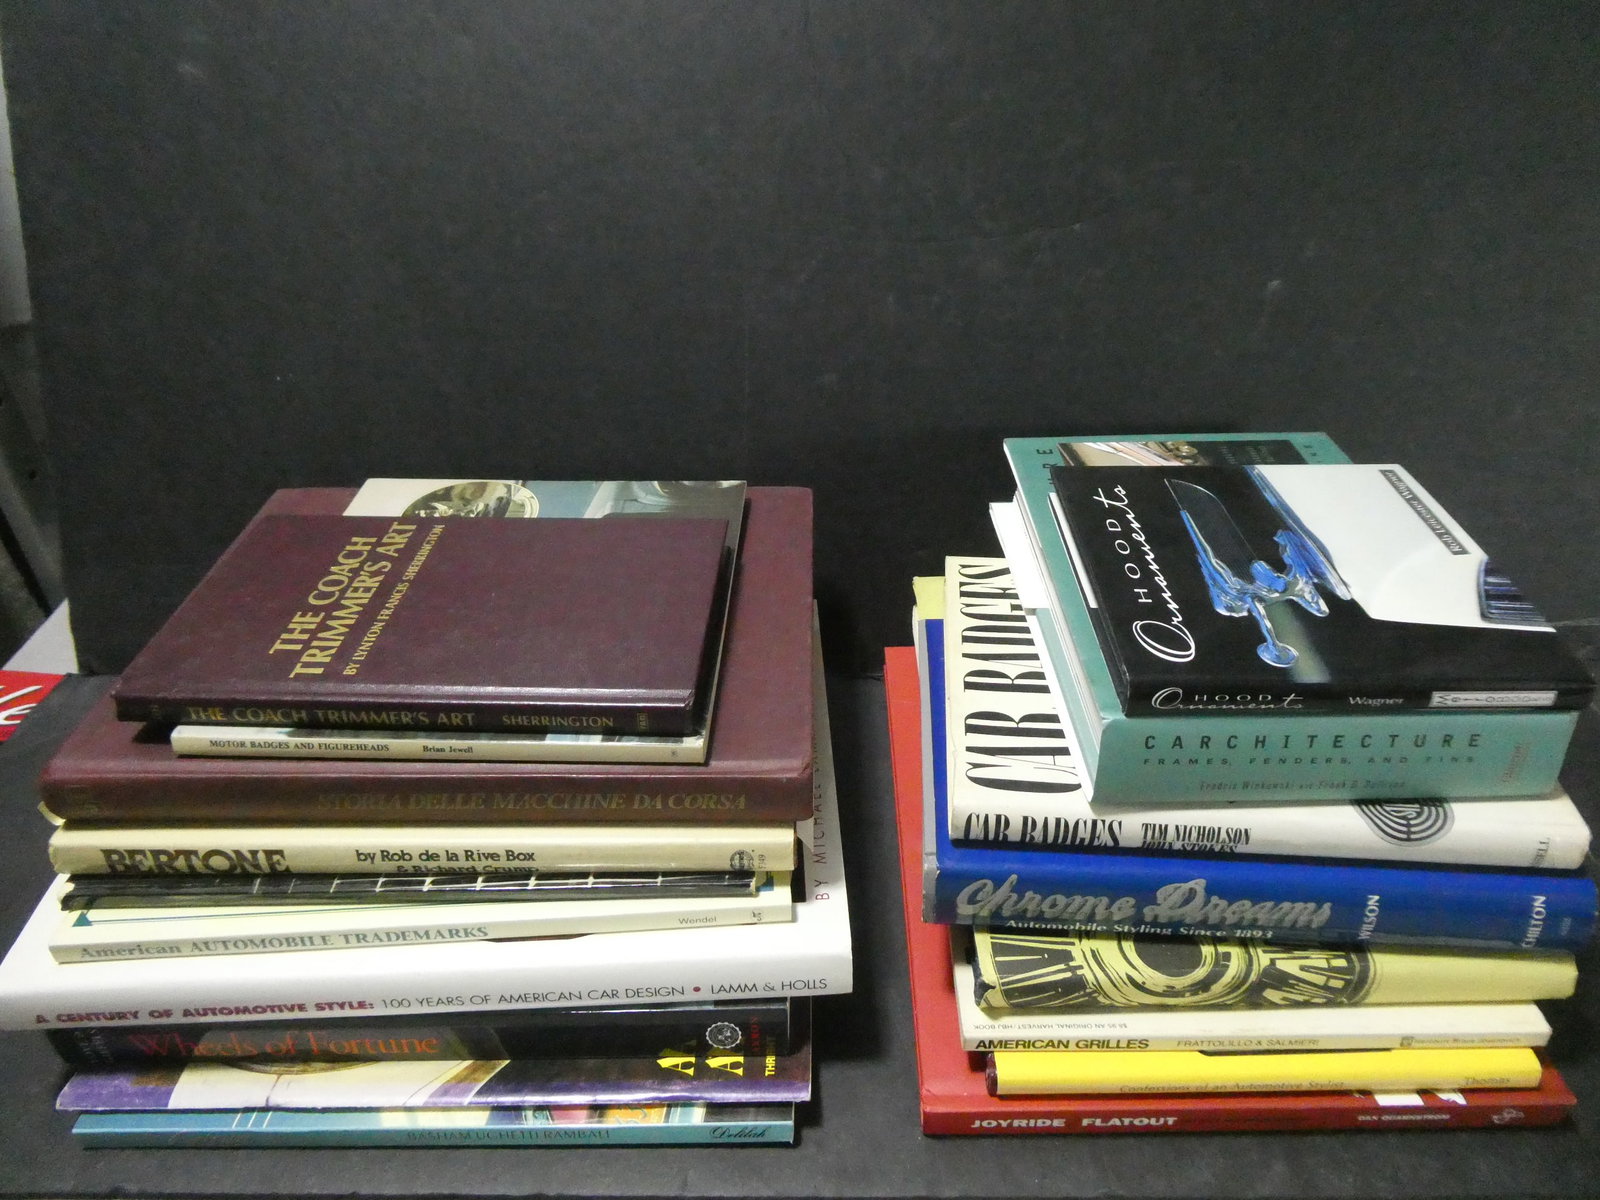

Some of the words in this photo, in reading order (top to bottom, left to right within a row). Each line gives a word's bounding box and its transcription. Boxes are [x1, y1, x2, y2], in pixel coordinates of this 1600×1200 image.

[1093, 484, 1195, 662] Ornaments
[1106, 519, 1153, 604] HOOD
[268, 611, 325, 655] THE
[308, 536, 378, 606] COACH
[289, 561, 392, 678] TRIMMER'S
[383, 521, 418, 559] ART
[343, 662, 361, 676] BY
[356, 622, 385, 661] LYNTON
[379, 580, 410, 622] FRANCIS
[405, 524, 446, 580] SHERRINGTON
[958, 564, 1052, 693] BADGES
[1193, 694, 1273, 703] HOOD
[1348, 695, 1404, 708] Wagner
[187, 707, 227, 722] THE
[234, 707, 307, 723] COACH
[315, 709, 430, 725] TRIMMER'S
[437, 712, 475, 727] ART
[502, 714, 614, 727] SHERRINGTON
[209, 739, 247, 749] MOTOR
[250, 740, 290, 750] BADGES
[292, 741, 315, 750] AND
[318, 742, 390, 752] FIGUREHEADS
[422, 744, 446, 754] Brian
[448, 745, 474, 755] Jewell
[965, 711, 1082, 793] CAR
[1144, 732, 1482, 751] CARCHITECTURE
[1367, 756, 1409, 765] AND
[407, 792, 486, 809] DELLE
[493, 793, 626, 809] MACCHINE
[633, 793, 663, 809] DA
[668, 793, 746, 809] CORSA
[964, 813, 1011, 842] CAR
[1016, 815, 1123, 847] BADGES
[1140, 823, 1171, 843] TIM
[1173, 824, 1251, 846] NICHOLSON
[100, 849, 290, 874] BERTONE
[356, 850, 376, 865] by
[380, 850, 413, 862] Rob
[419, 849, 440, 862] de
[446, 849, 459, 862] la
[464, 849, 501, 862] Rive
[505, 849, 536, 862] Box
[815, 878, 829, 901] BY
[956, 873, 1137, 921] Chrome
[679, 914, 717, 925] Wendel
[1005, 920, 1109, 932] Automobile
[1112, 923, 1173, 936] Styling
[1179, 926, 1228, 937] Since
[1358, 895, 1380, 940] WILSON
[1521, 895, 1547, 948] CHILTON
[80, 943, 182, 960] American
[191, 935, 334, 954] AUTOMOBILE
[338, 925, 488, 946] TRADEMARKS
[35, 1014, 50, 1025] A
[56, 1009, 140, 1023] CENTURY
[148, 1008, 174, 1019] OF
[182, 1002, 309, 1017] AUTOMOTIVE
[314, 999, 375, 1012] STYLE:
[381, 998, 412, 1009] 100
[415, 993, 471, 1008] YEARS
[473, 992, 492, 1006] OF
[497, 988, 583, 1005] AMERICAN
[587, 987, 620, 1001] CAR
[625, 984, 686, 999] DESIGN
[711, 981, 758, 995] LAMM
[763, 980, 777, 991] &
[781, 977, 828, 991] HOLLS
[128, 1031, 257, 1058] Wheels
[265, 1031, 293, 1057] of
[295, 1030, 439, 1057] Fortune
[975, 1038, 1072, 1050] AMERICAN
[1075, 1038, 1150, 1050] GRILLES
[971, 1118, 1066, 1129] JOYRIDE
[1081, 1117, 1178, 1127] FLATOUT
